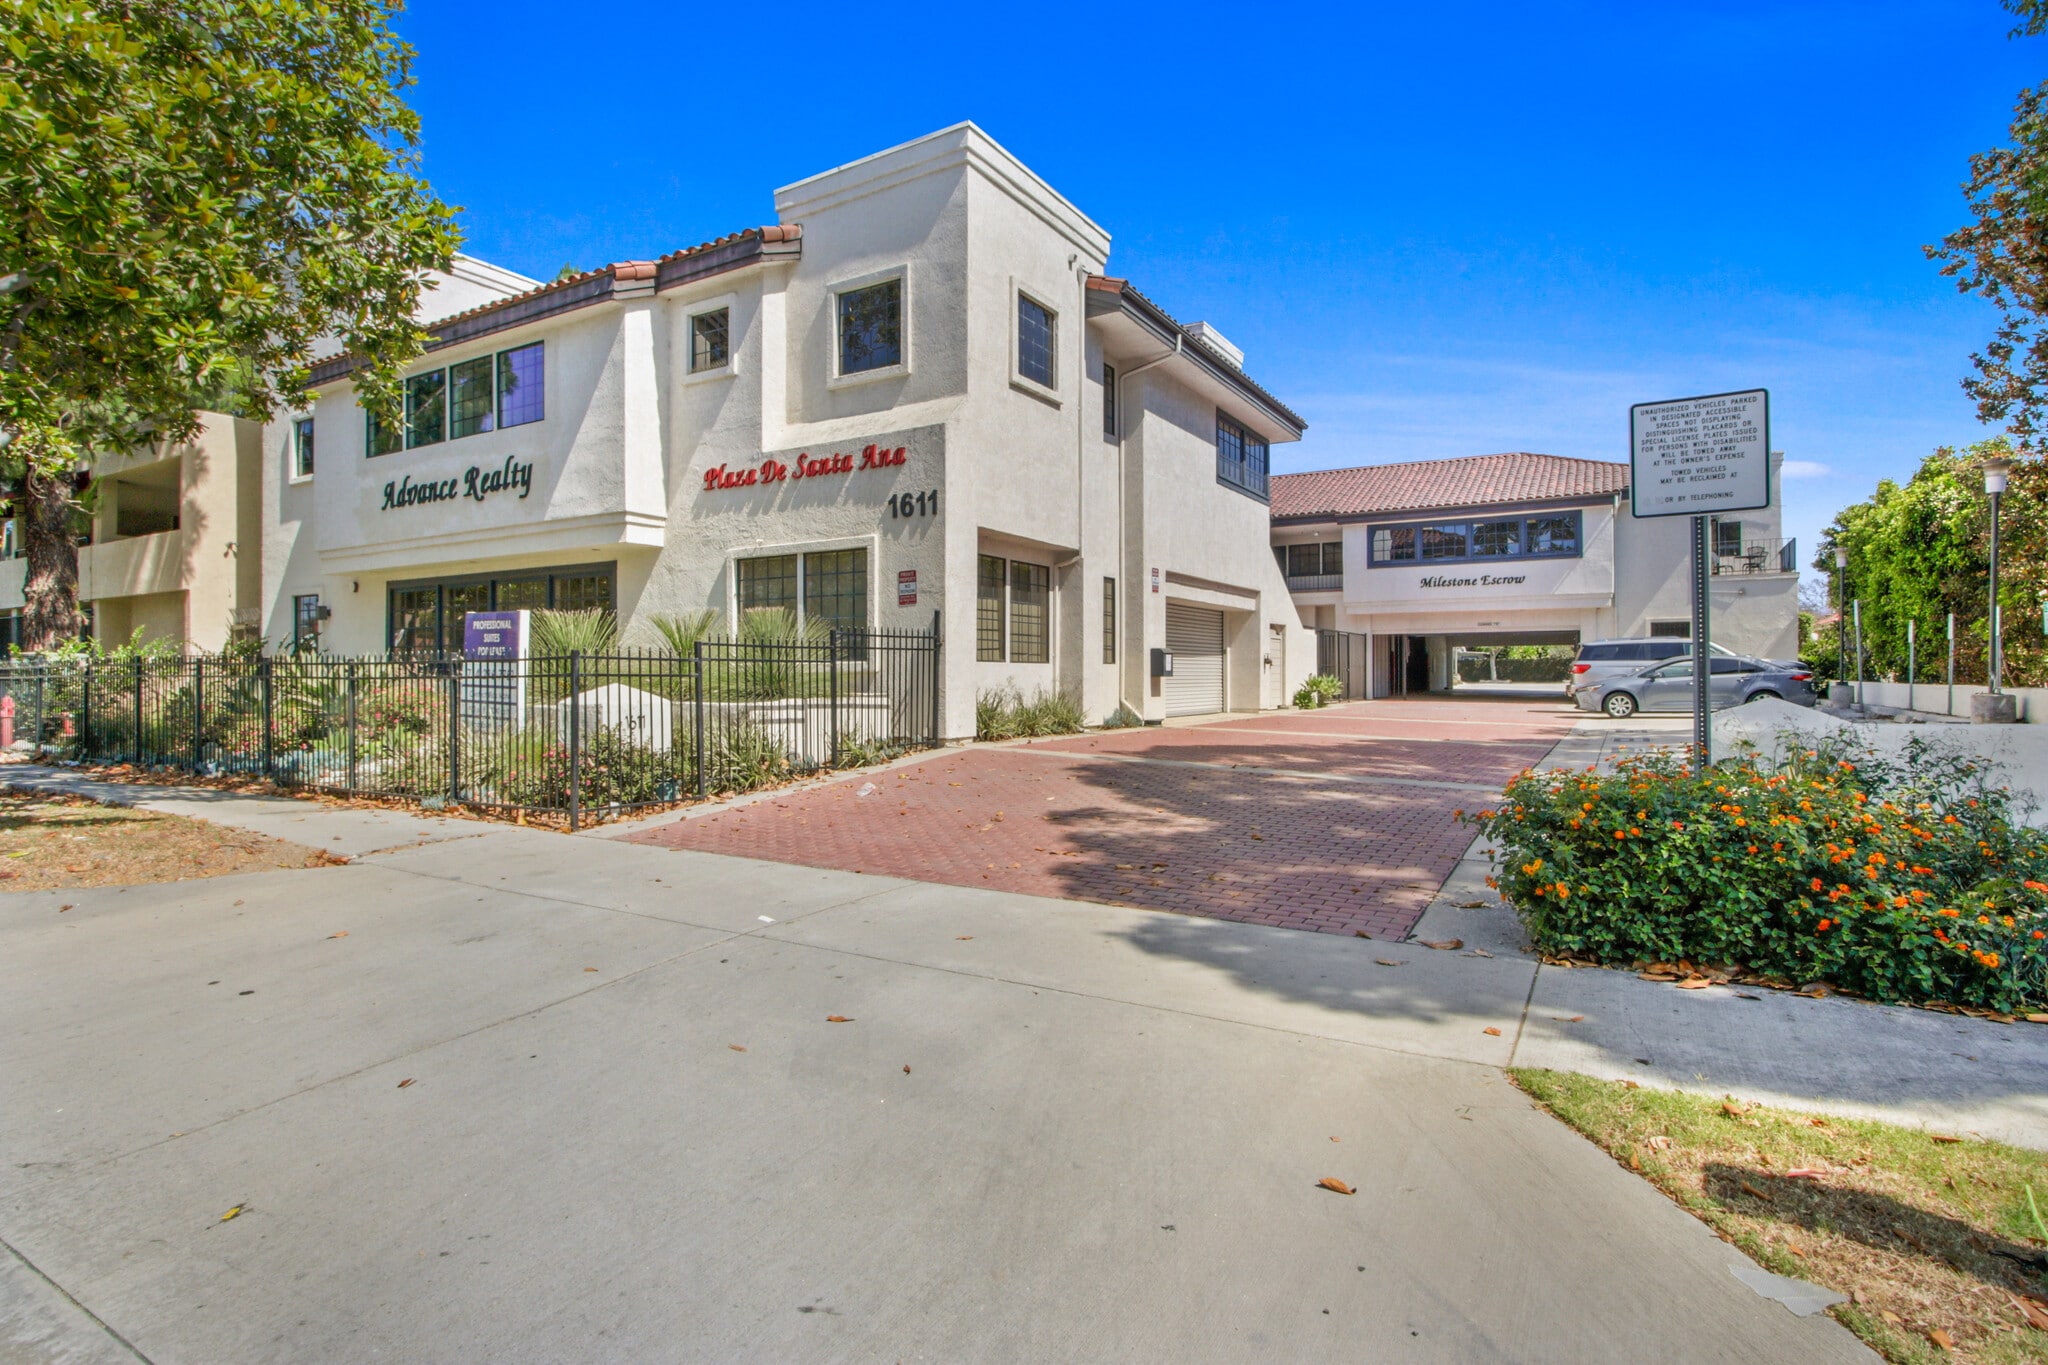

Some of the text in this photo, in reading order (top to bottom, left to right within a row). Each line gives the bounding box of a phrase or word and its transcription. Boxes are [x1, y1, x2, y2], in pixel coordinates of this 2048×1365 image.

[1641, 396, 1757, 416] UNAUTHORIZED VEHICLES PARKED
[1662, 411, 1700, 421] DESIGNATED
[1706, 405, 1746, 415] ACCESSIBLE
[1702, 414, 1741, 424] DISPLAYING
[1646, 427, 1698, 437] DISTINGUISHING
[1703, 422, 1738, 431] PLACARDS
[1641, 438, 1667, 446] SPECIAL
[1672, 434, 1699, 442] LICENSE
[1658, 443, 1688, 451] PERSONS
[1713, 436, 1757, 445] DISABILITIES
[1681, 456, 1710, 464] OWNER'S
[1715, 452, 1745, 460] EXPENSE
[703, 443, 906, 491] Plaza De Santa Ana
[1696, 466, 1726, 474] VEHICLES
[381, 455, 533, 511] Advance Realty
[1690, 474, 1726, 482] RECLAIMED
[1691, 491, 1734, 500] TELEPHONING
[888, 489, 938, 519] 1611
[1420, 574, 1526, 588] Milestone Escrow
[473, 620, 512, 629] PROFESSIONAL
